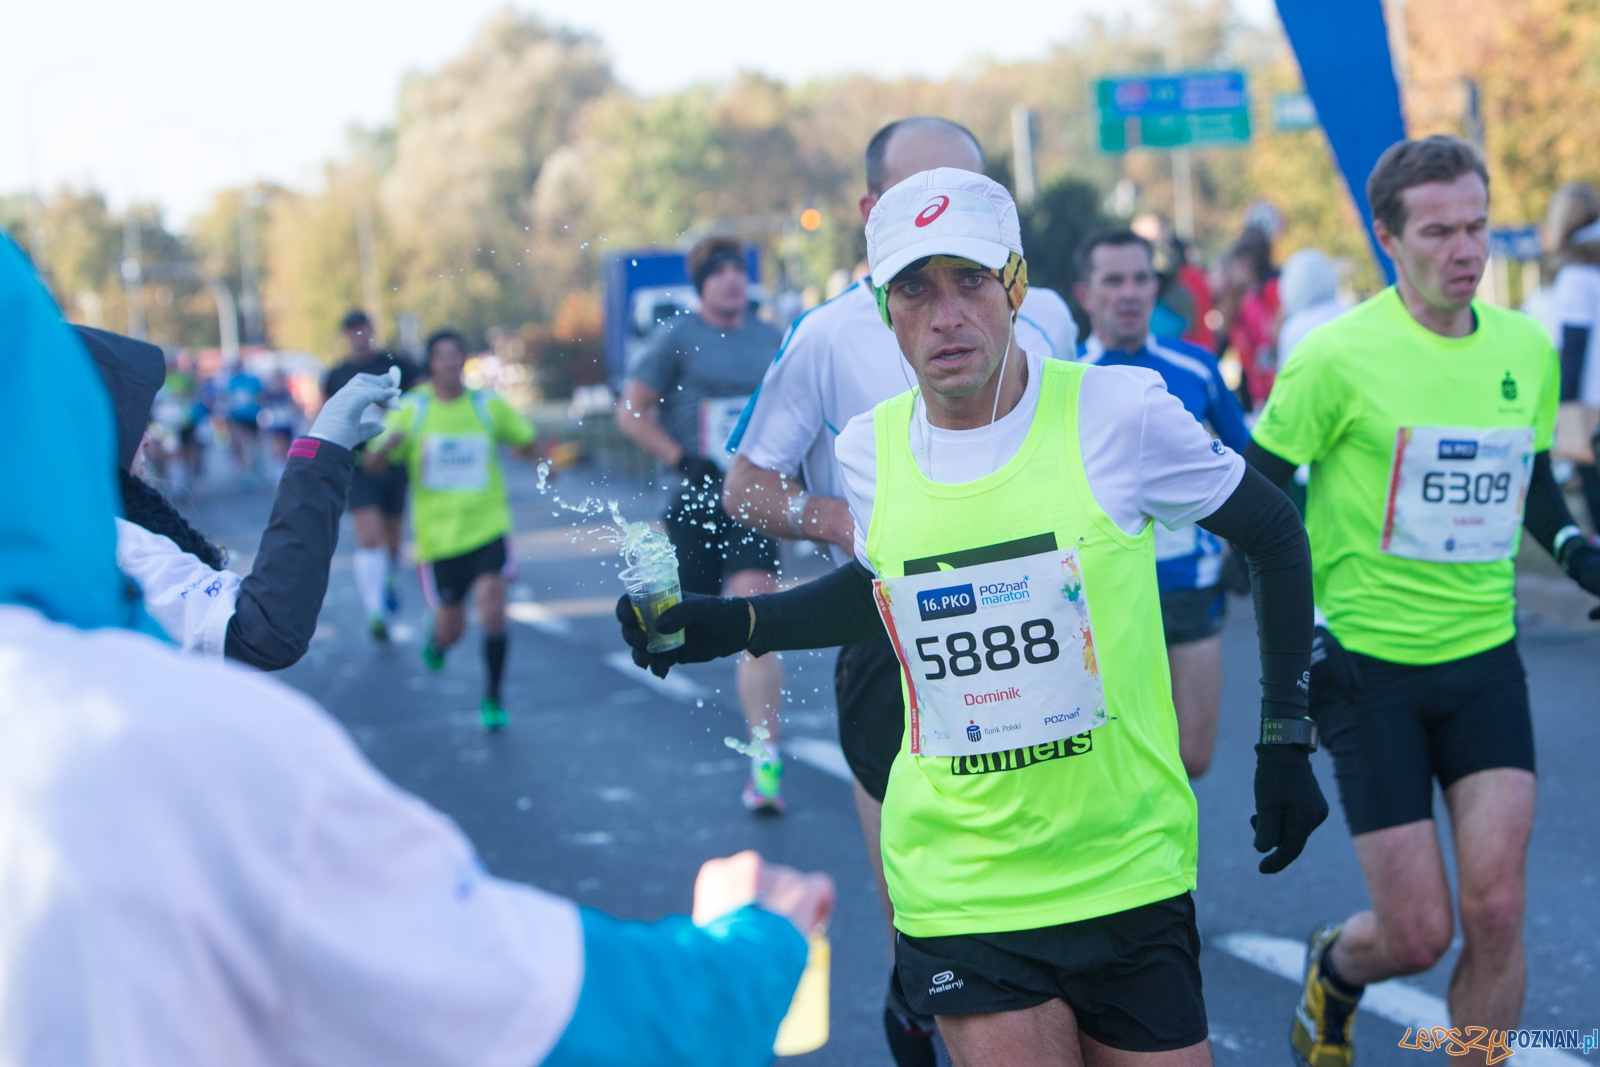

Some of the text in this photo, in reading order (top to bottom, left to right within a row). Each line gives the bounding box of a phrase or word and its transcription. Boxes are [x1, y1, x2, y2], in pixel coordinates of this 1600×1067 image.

[1423, 472, 1511, 504] 6309
[922, 593, 970, 612] 16. PKO
[981, 590, 1030, 605] maraton
[915, 618, 1060, 680] 5888
[964, 686, 1022, 706] Dominik
[984, 722, 1022, 735] Bank Polski
[929, 978, 964, 995] Kalenji
